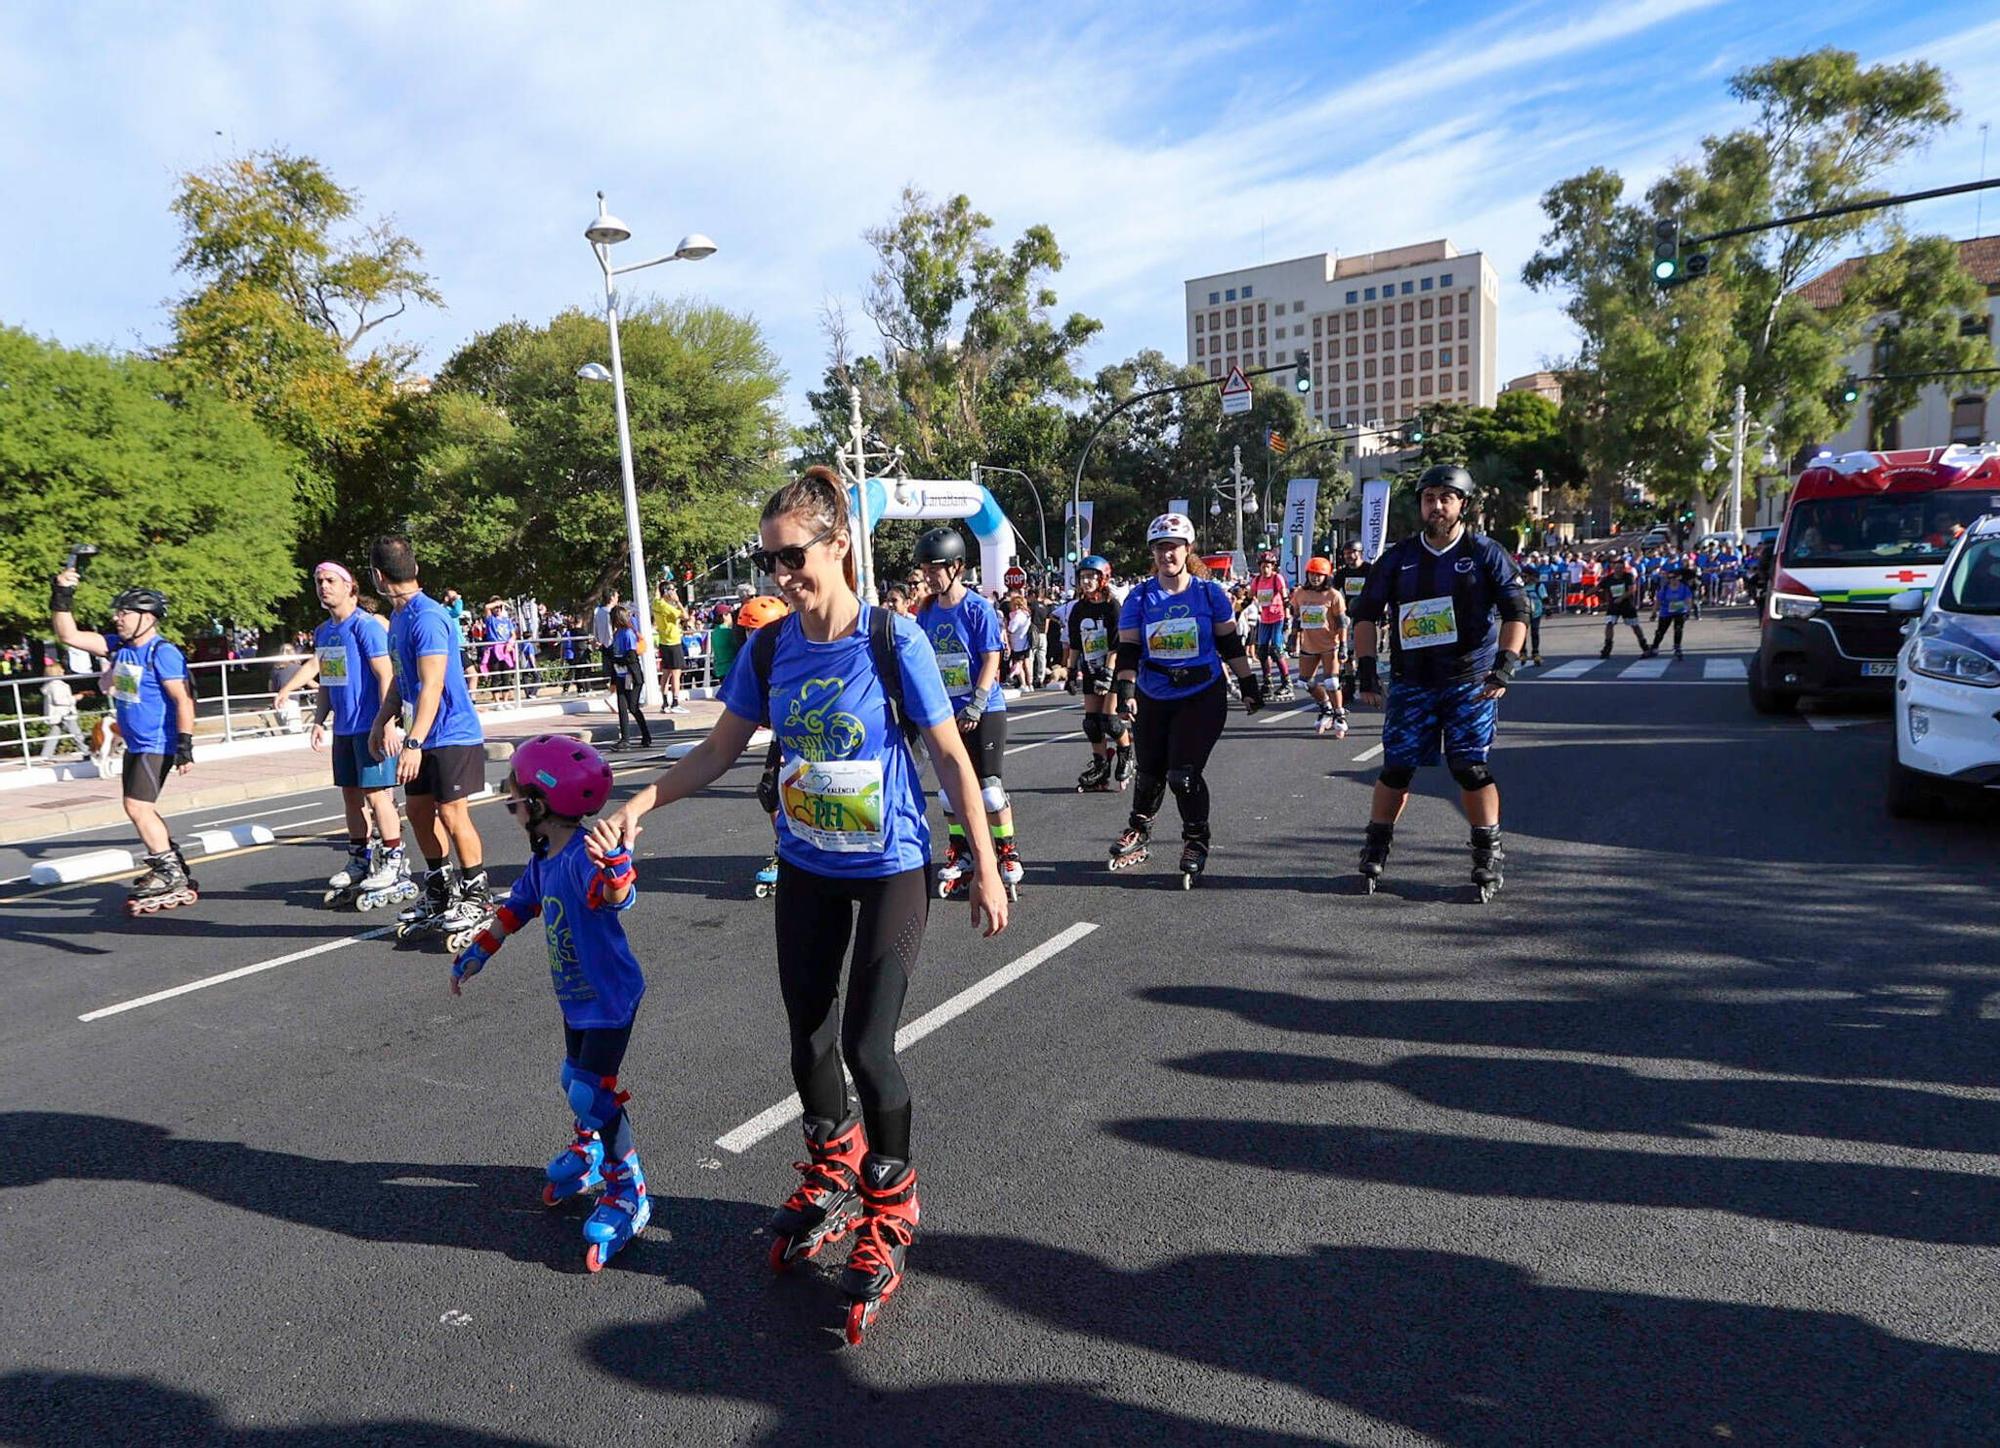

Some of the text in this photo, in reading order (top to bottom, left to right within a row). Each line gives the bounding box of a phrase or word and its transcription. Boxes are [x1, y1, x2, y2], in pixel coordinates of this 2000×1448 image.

[1005, 574, 1025, 585] STOP
[1871, 663, 1897, 674] 577
[797, 735, 824, 750] SOY
